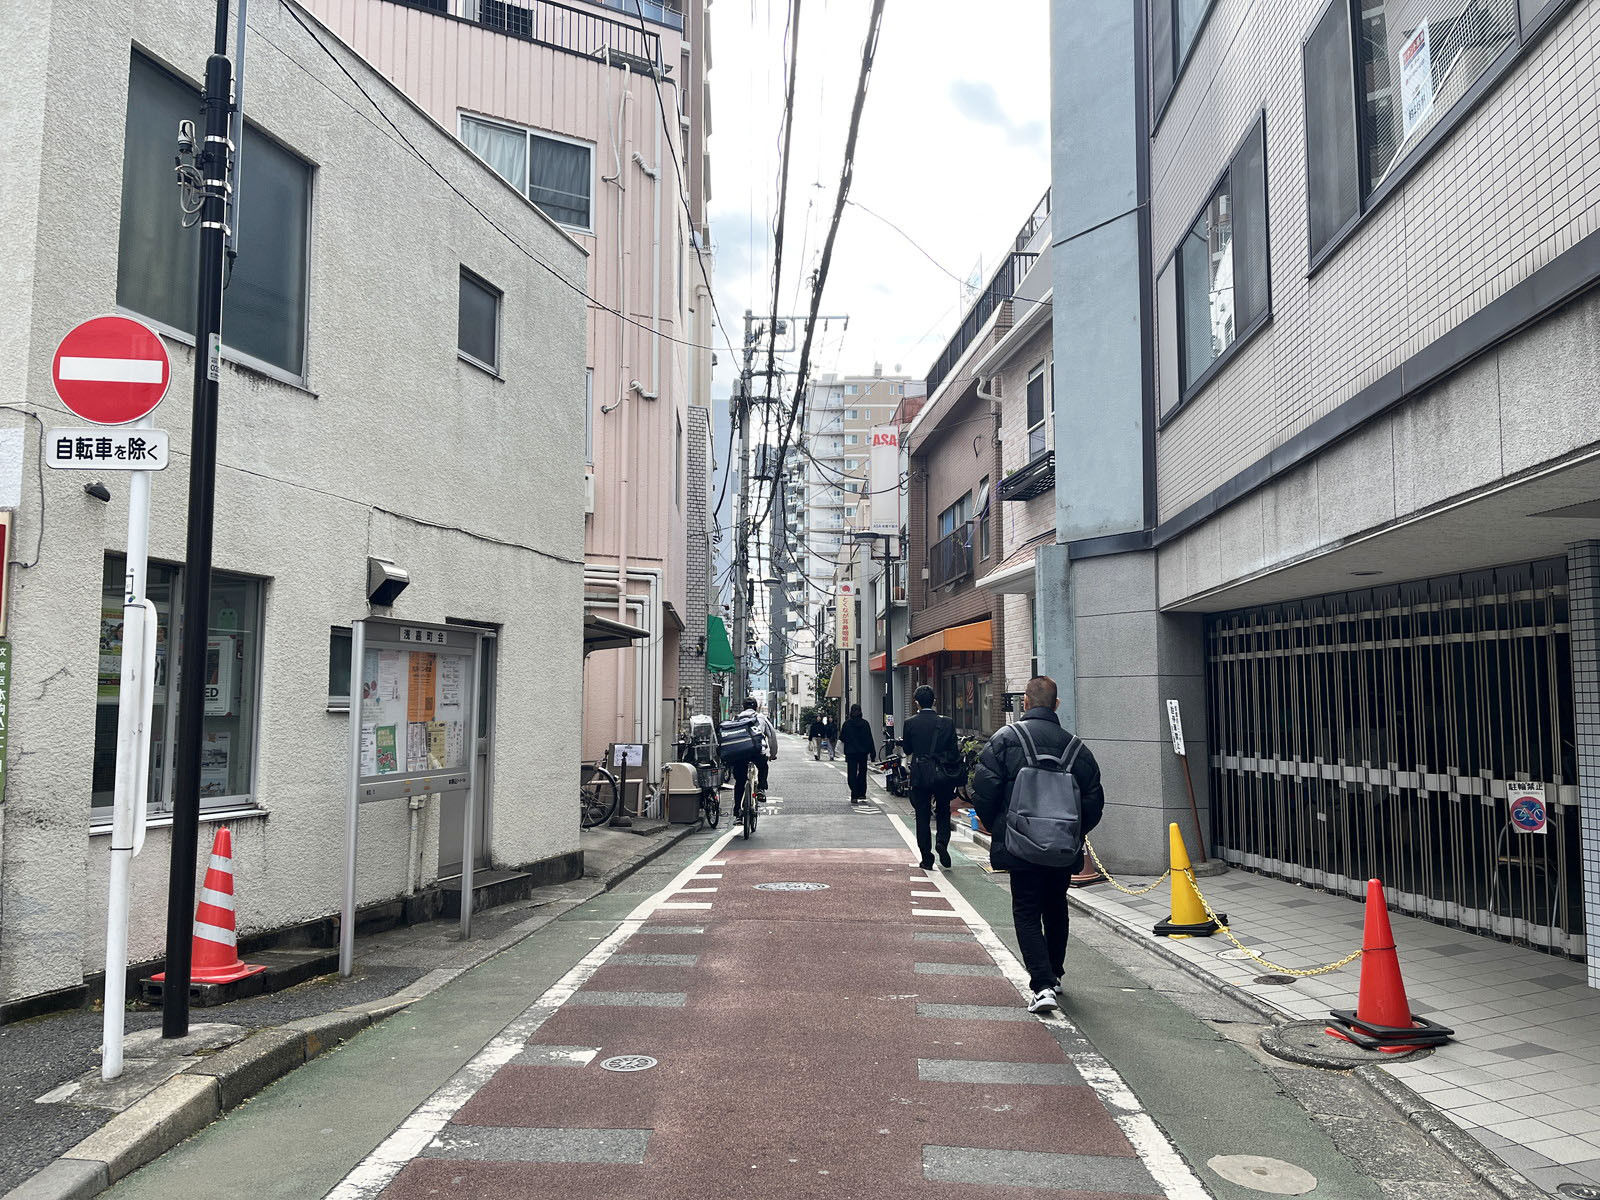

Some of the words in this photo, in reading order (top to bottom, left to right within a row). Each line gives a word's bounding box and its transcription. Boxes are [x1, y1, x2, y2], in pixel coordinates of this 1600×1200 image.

[872, 433, 897, 447] ASA
[56, 437, 158, 461] 自転車を除く
[1508, 782, 1544, 791] 駐輪禁止
